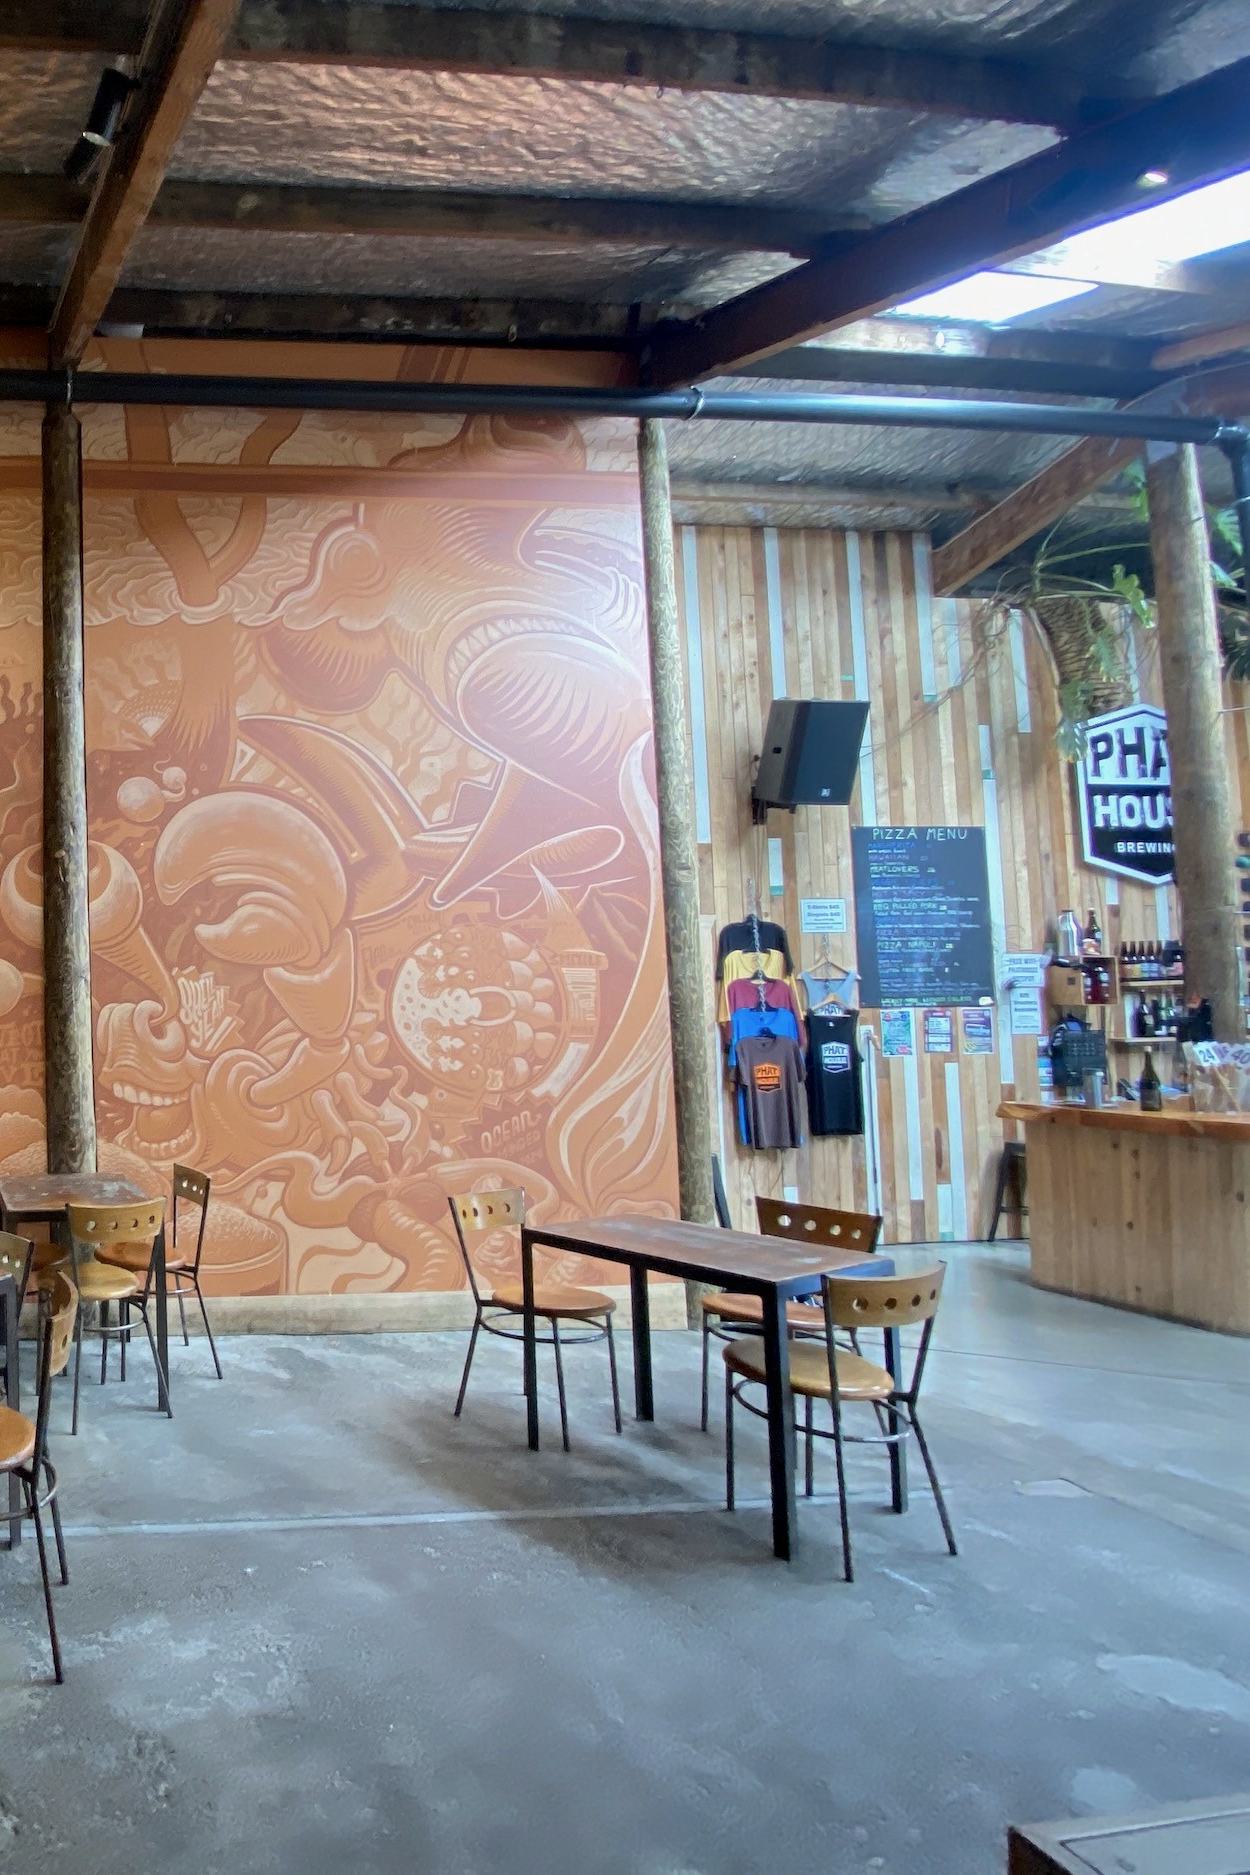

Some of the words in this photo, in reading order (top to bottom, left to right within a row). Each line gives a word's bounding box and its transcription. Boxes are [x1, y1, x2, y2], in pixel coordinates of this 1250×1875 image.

[872, 828, 918, 840] PIZZA
[926, 828, 968, 840] MENU
[1117, 842, 1175, 853] BREWIN
[823, 1046, 847, 1055] PHAT
[1198, 1053, 1216, 1064] 24
[756, 1067, 778, 1076] PHAT
[480, 1109, 544, 1154] OCEAN
